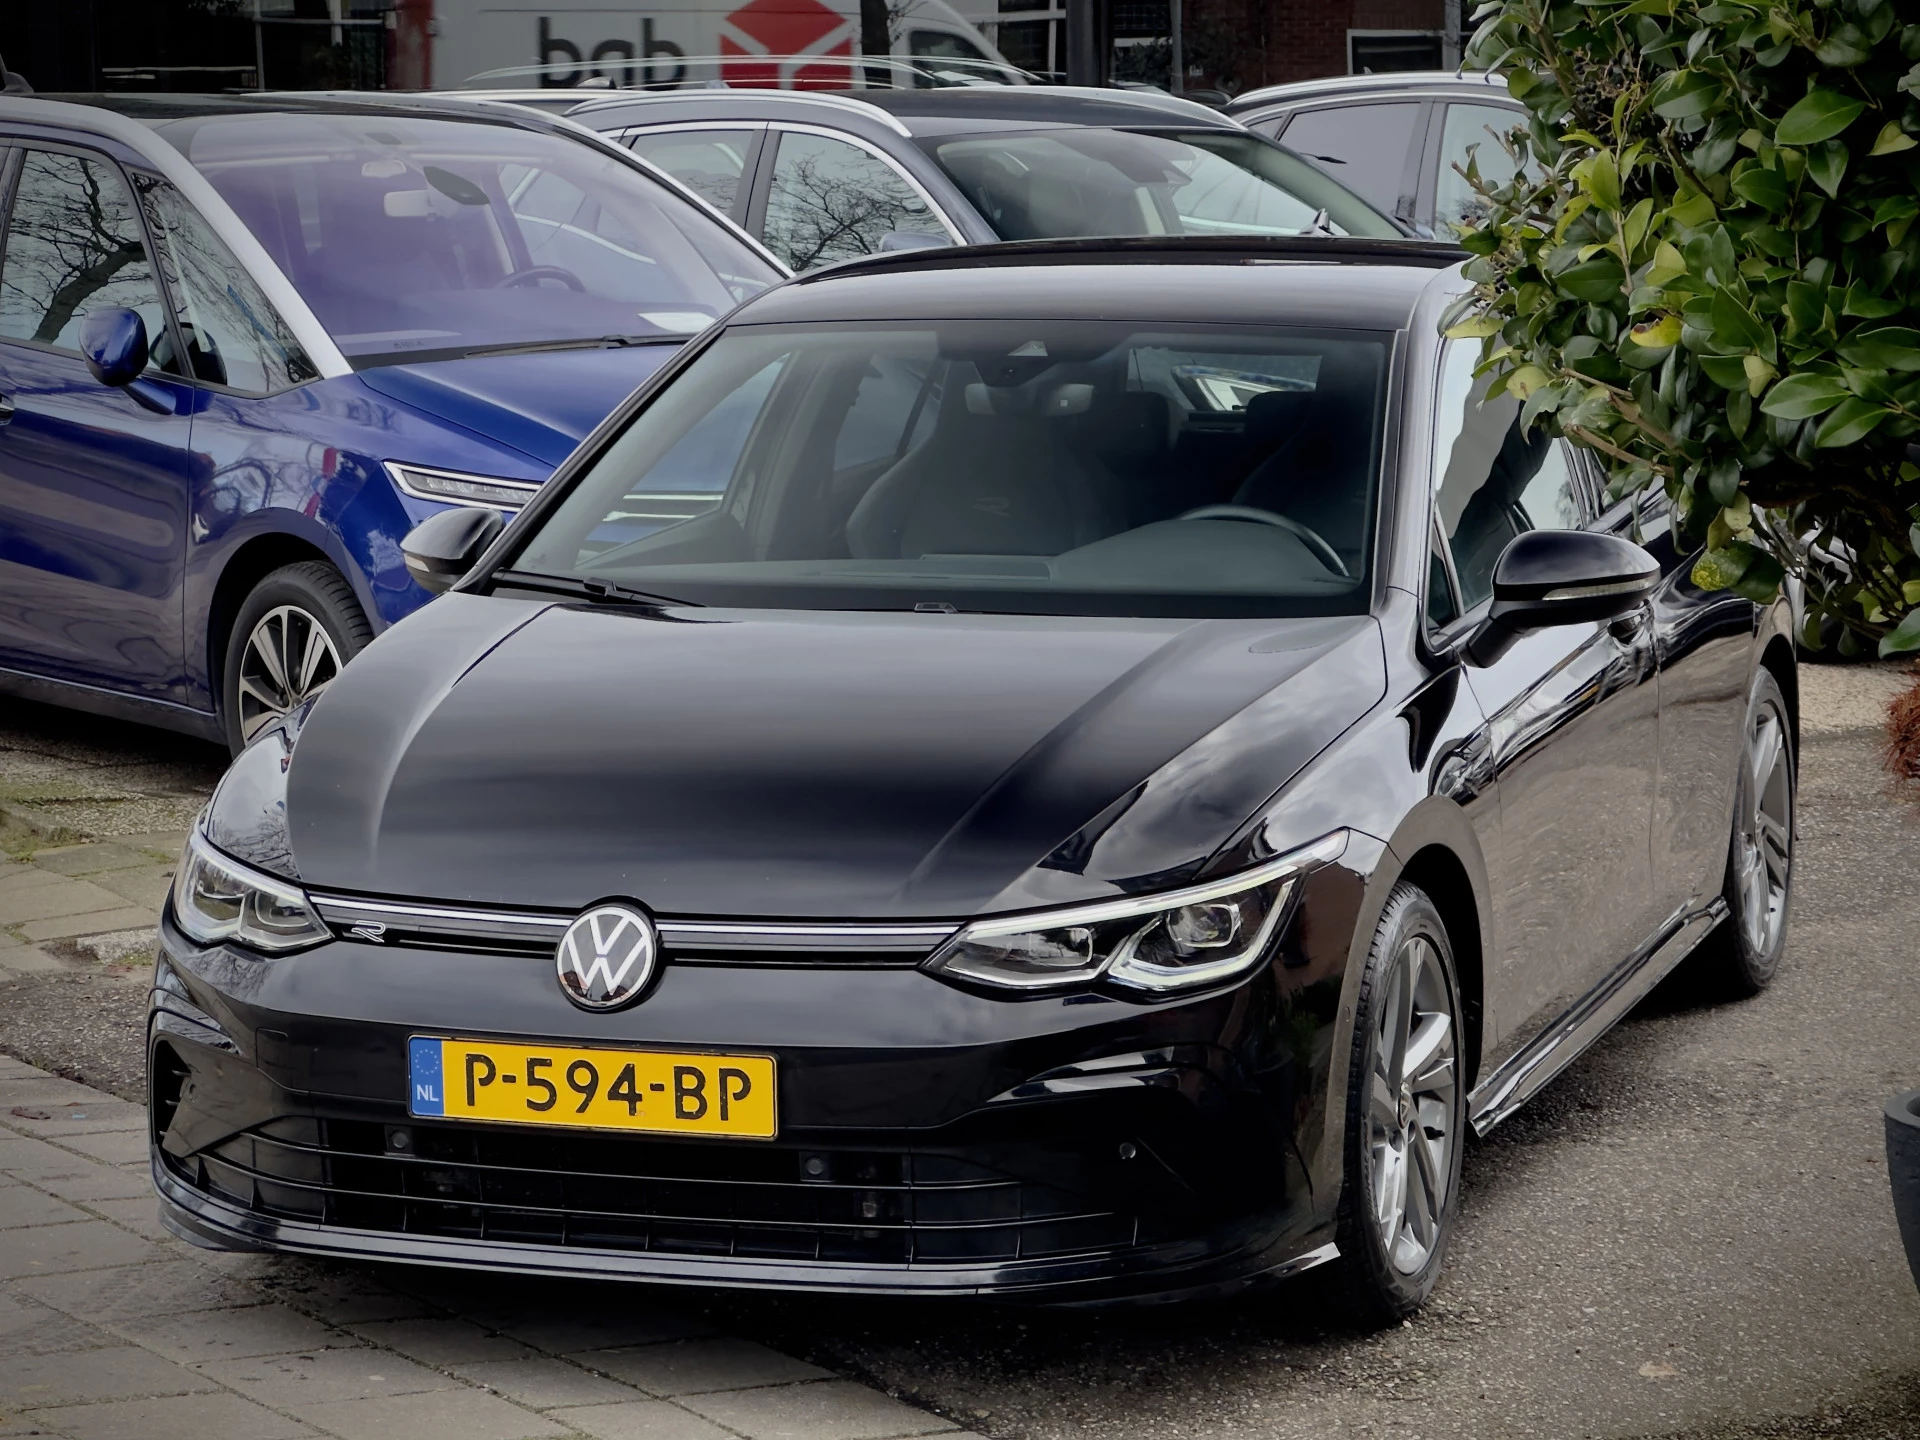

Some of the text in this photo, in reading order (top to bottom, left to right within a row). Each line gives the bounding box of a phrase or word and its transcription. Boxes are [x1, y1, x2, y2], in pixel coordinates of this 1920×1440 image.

[351, 919, 386, 943] R
[416, 1053, 752, 1121] NL P-594-BP
